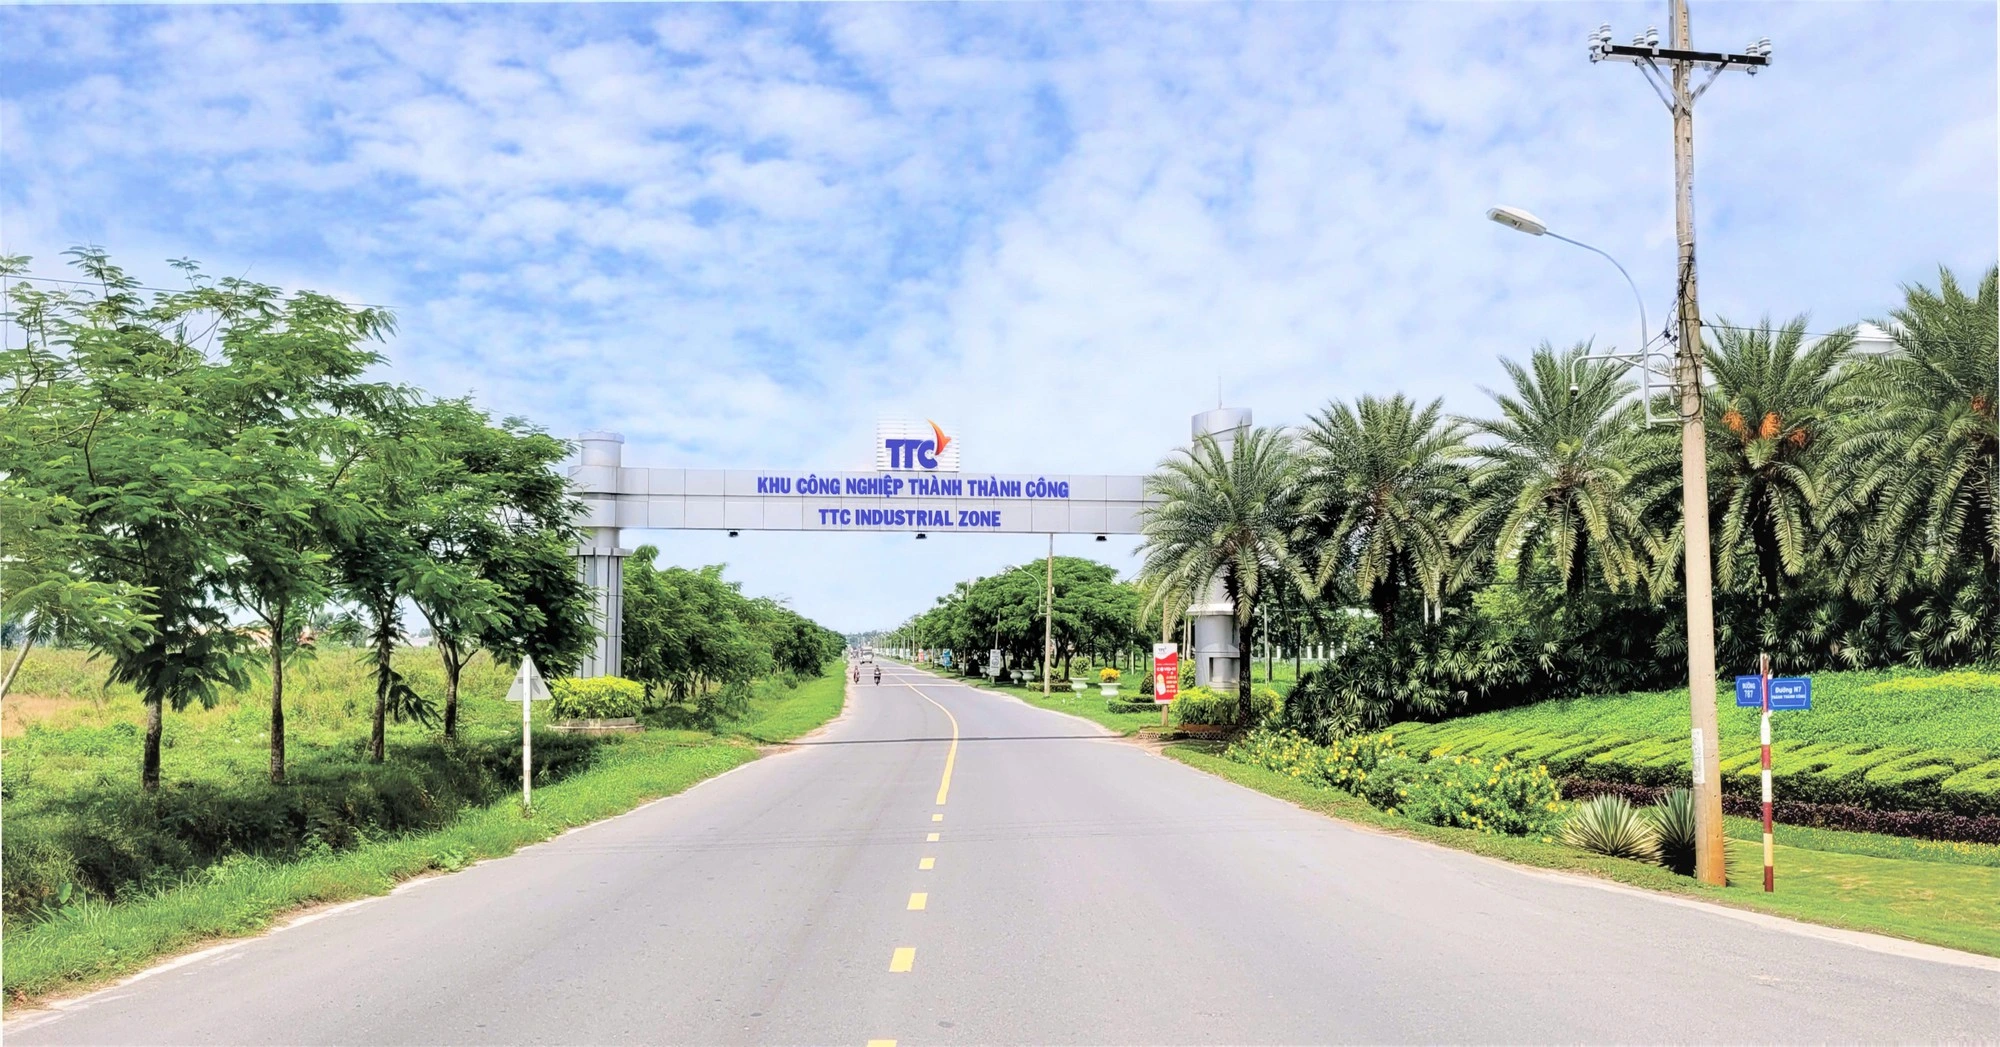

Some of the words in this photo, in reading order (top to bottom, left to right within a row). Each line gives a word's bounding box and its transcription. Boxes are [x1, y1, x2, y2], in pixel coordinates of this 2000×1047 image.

[886, 439, 938, 468] TTC
[757, 477, 791, 494] KHU
[796, 474, 841, 495] CÔNG
[846, 475, 904, 498] NGHIỆP
[908, 475, 962, 496] THÀNH
[967, 476, 1021, 497] THÀNH
[1025, 477, 1069, 498] CÔNG
[818, 509, 851, 525] TTC
[855, 509, 954, 526] INDUSTRIAL
[958, 511, 1001, 527] ZONE
